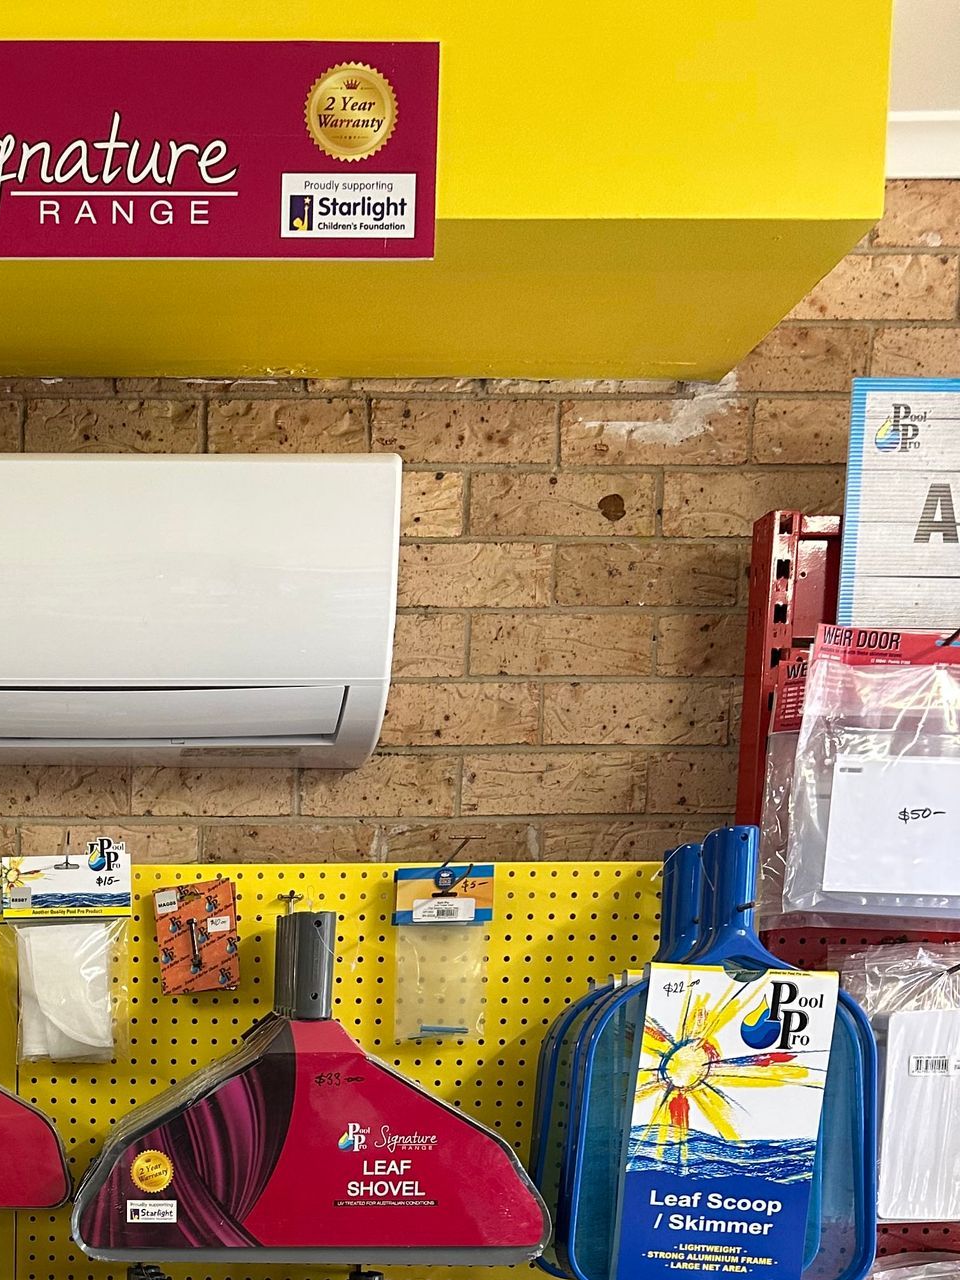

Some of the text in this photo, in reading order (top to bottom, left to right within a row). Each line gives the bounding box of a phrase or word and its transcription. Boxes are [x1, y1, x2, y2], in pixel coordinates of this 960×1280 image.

[324, 96, 376, 111] 2 Year
[317, 114, 385, 132] Warranty
[304, 181, 393, 192] Proudly supporting
[40, 200, 211, 225] RANGE
[318, 197, 407, 221] Starlight
[318, 222, 406, 231] Children's Foundation
[892, 403, 927, 430] Pool
[900, 424, 920, 452] Pro
[823, 627, 901, 650] WEIR DOOR
[769, 981, 824, 1021] Pool
[776, 1010, 810, 1049] Pro
[374, 1126, 438, 1152] Signature
[363, 1160, 412, 1176] LEAF
[347, 1180, 425, 1197] SHOVEL
[649, 1189, 782, 1214] Leaf Scoop
[141, 1208, 173, 1219] Starlight
[653, 1212, 774, 1235] / Skimmer
[647, 1251, 773, 1266] STRONG ALUMINIUM FRAME
[678, 1243, 742, 1254] LIGHTWEIGHT
[670, 1262, 748, 1273] LARGE NET AREA
